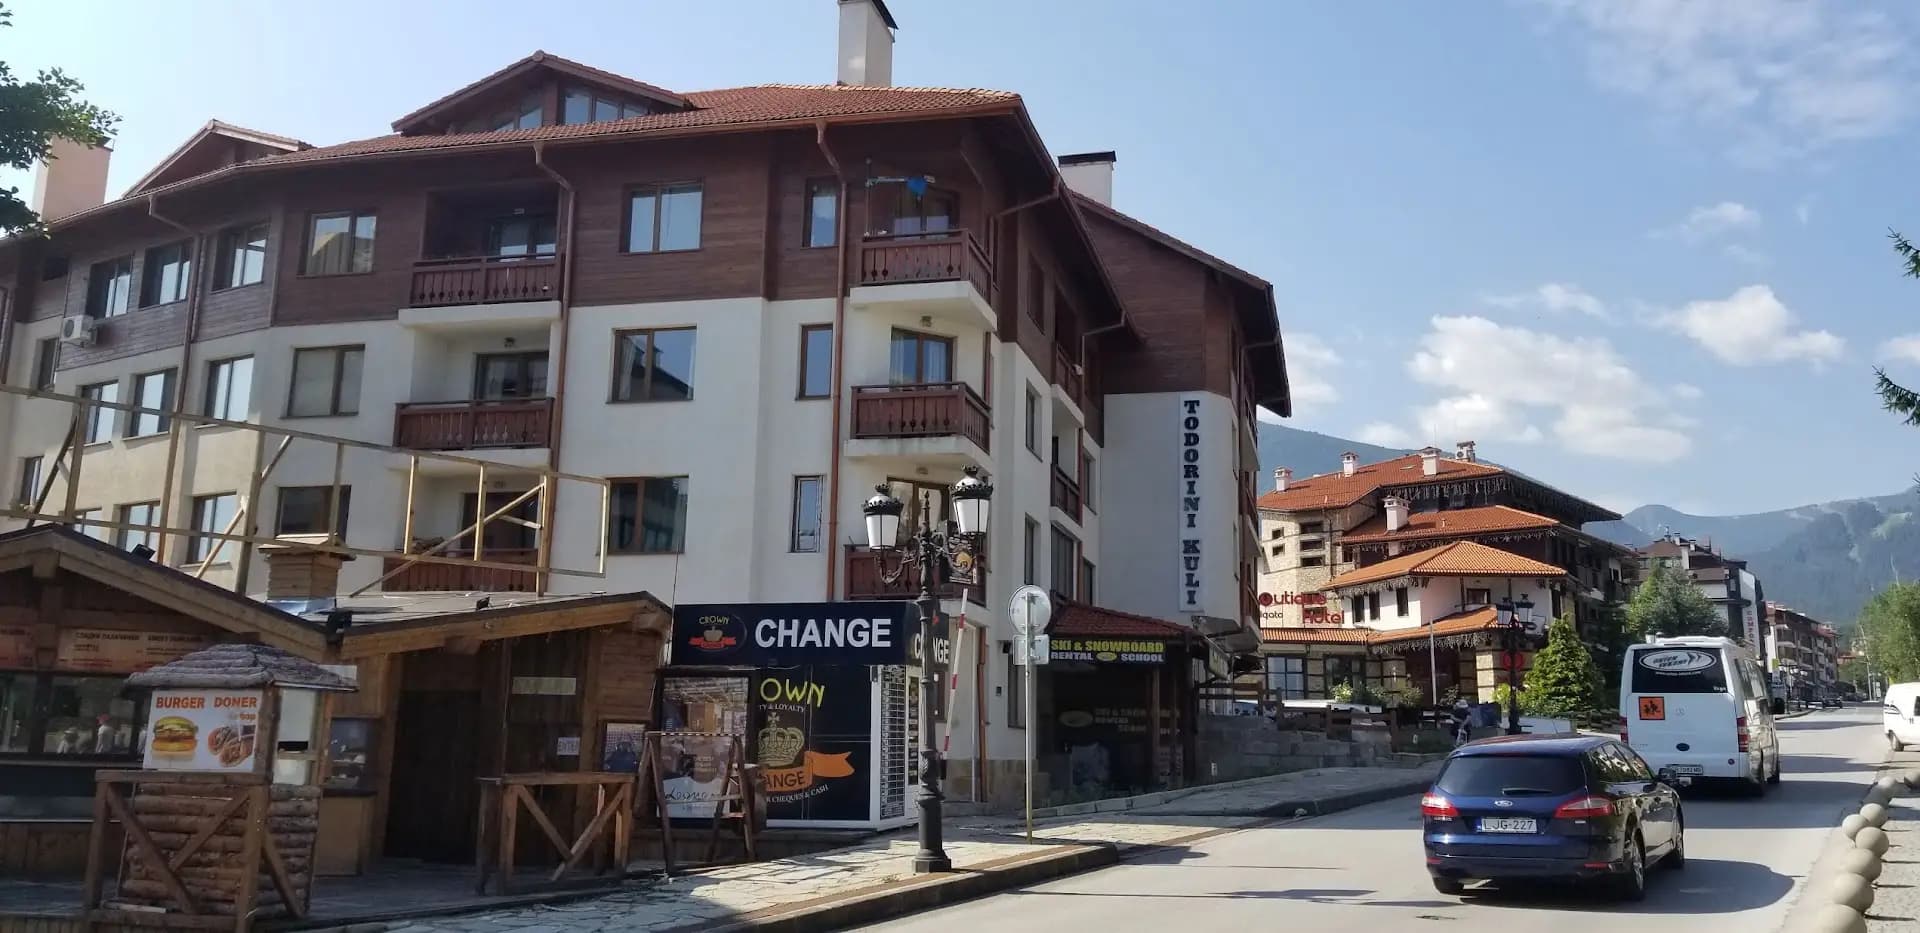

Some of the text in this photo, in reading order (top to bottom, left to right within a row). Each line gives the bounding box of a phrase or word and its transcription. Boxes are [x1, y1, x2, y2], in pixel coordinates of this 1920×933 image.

[1183, 400, 1200, 605] TODORINI KULI
[699, 615, 730, 625] CROWN
[1303, 608, 1345, 624] Hotel
[755, 618, 892, 648] CHANGE
[914, 633, 950, 664] CNGE
[1051, 640, 1164, 653] SKI & SNOWBOARD
[1051, 652, 1094, 661] RENTAL
[1121, 653, 1165, 662] SCHOOL
[760, 678, 825, 707] OWN
[156, 696, 257, 709] BURGER DONER
[775, 703, 806, 713] LOYALTY
[764, 772, 806, 788] ANGE
[810, 784, 829, 796] CASH
[1484, 820, 1533, 831] LJG-227
